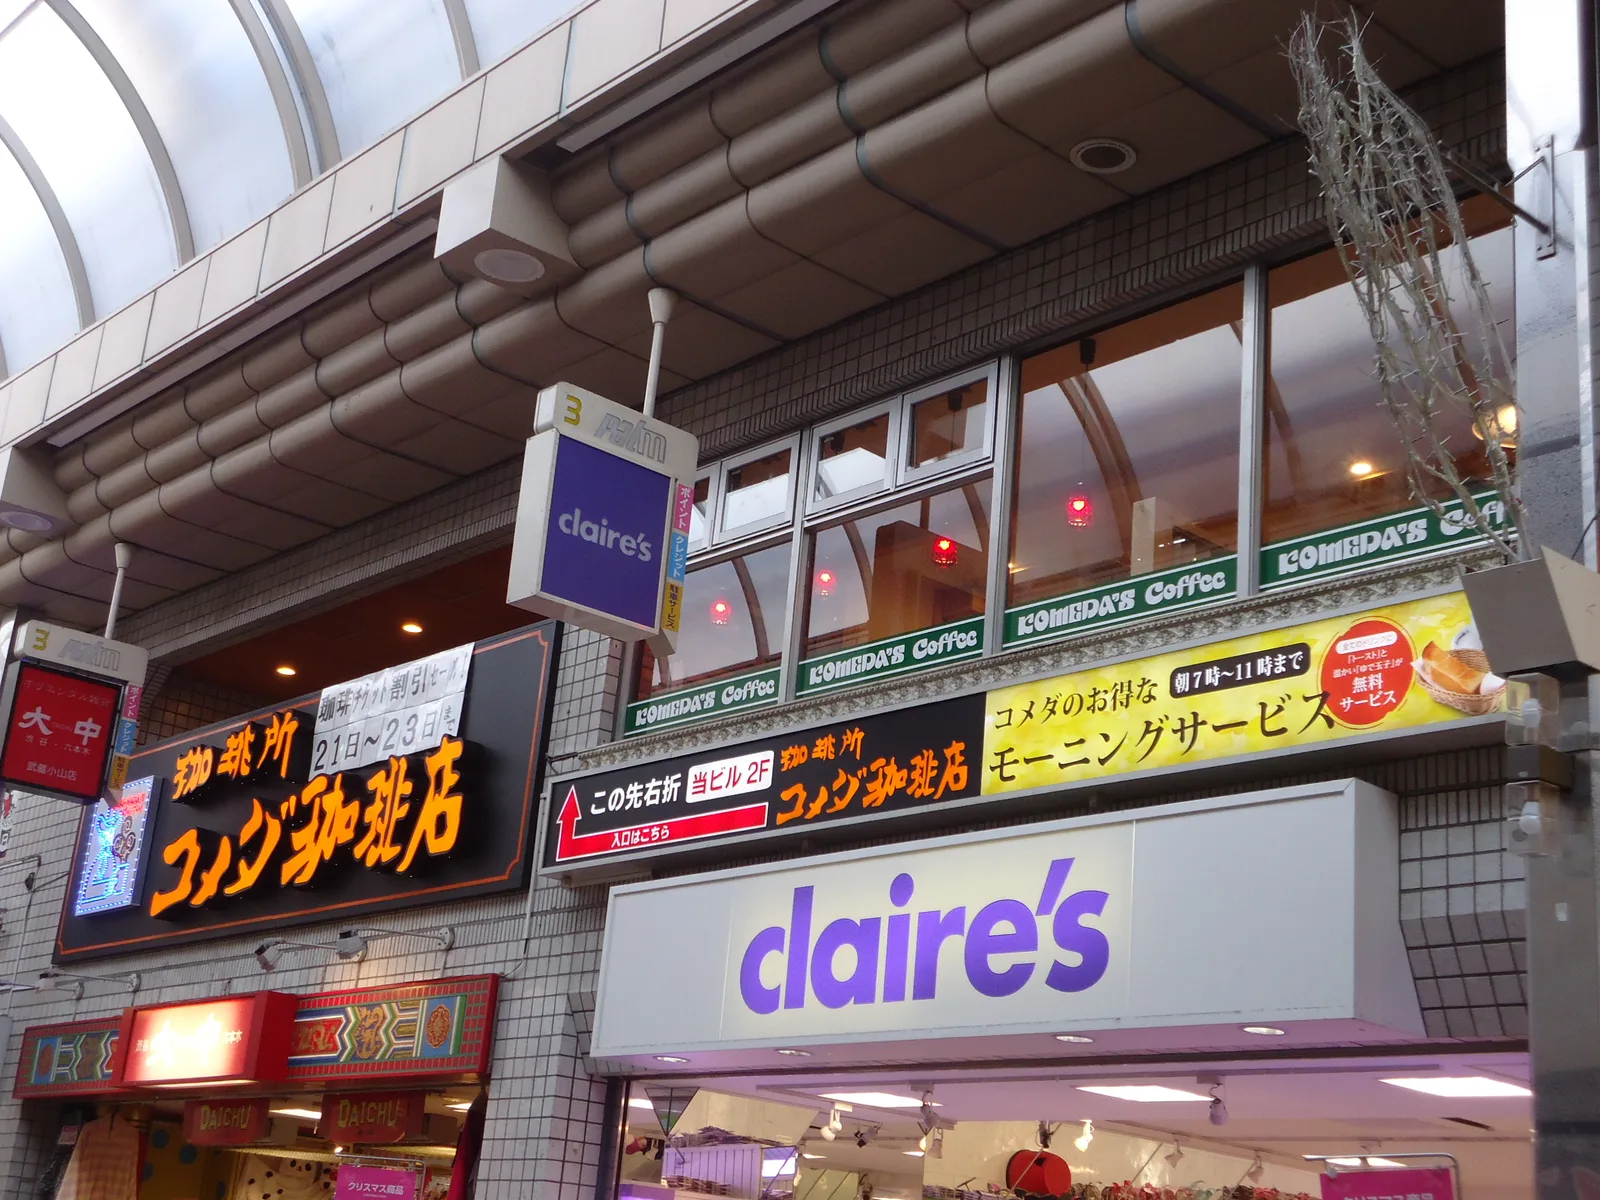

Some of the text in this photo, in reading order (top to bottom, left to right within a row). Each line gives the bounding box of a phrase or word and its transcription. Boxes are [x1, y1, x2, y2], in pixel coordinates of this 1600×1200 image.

[564, 394, 582, 426] 3
[678, 486, 692, 530] ポイント
[558, 507, 652, 562] claire's
[1278, 518, 1428, 576] KOMEDA'S
[671, 535, 685, 579] クレジット
[1017, 571, 1227, 636] KOMEDA'S Coffee
[32, 629, 49, 651] 3
[809, 629, 978, 686] KOMEDA'S Coffee
[127, 686, 140, 717] ポイント
[634, 678, 775, 727] KOMEDA'S Coffee
[995, 675, 1157, 732] コメダのお得な
[1339, 690, 1397, 713] サービス
[1352, 672, 1384, 694] 無料
[18, 706, 102, 746] 大 中
[988, 689, 1335, 784] モーニングサービス
[26, 760, 78, 782] 武蔵小山店
[172, 710, 300, 801] 珈琲所
[780, 728, 865, 772] 珈琲所
[589, 773, 682, 816] この先右折
[746, 758, 771, 784] 2F
[775, 740, 969, 826] コメダ珈琲店
[149, 735, 463, 918] コメダ珈琲店
[611, 824, 670, 848] 入口はこちら
[739, 857, 1110, 1015] claire's
[200, 1104, 251, 1131] DAICHU
[339, 1098, 401, 1128] DAICHU
[348, 1181, 404, 1195] クリスマス商品
